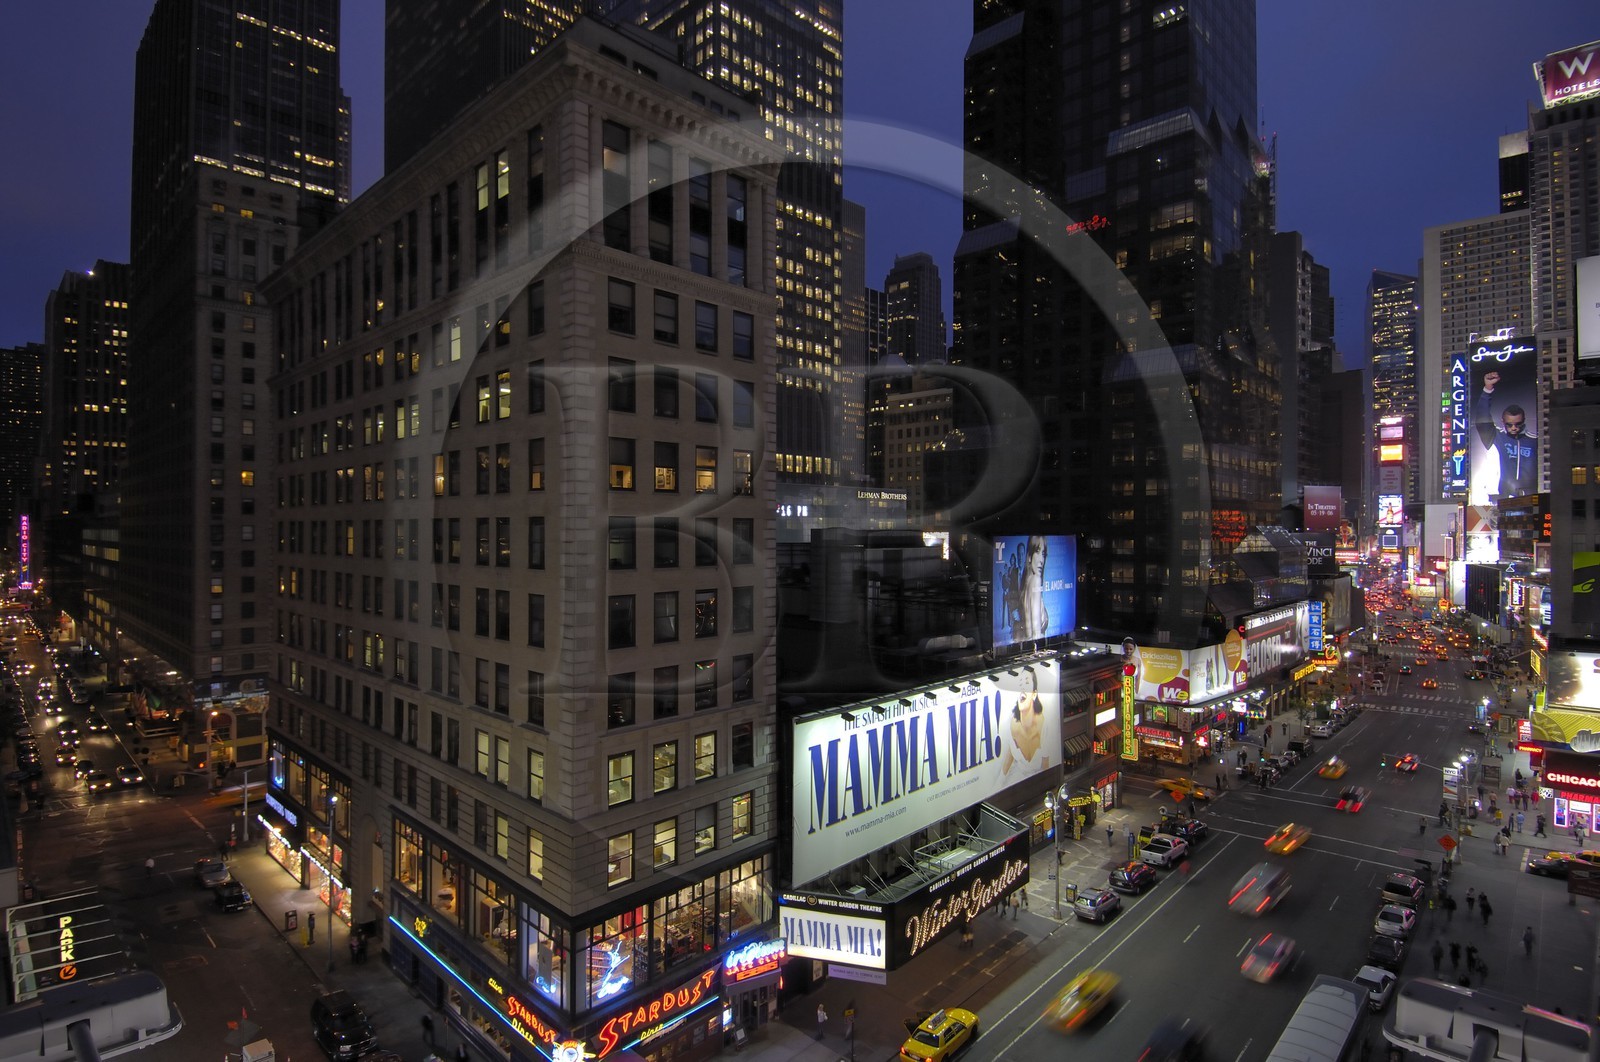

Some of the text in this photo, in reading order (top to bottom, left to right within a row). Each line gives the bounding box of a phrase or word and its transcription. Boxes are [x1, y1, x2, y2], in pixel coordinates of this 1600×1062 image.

[1558, 52, 1595, 79] W
[1451, 359, 1466, 445] ARGENT
[857, 490, 907, 500] LEHMAN BROTHERS
[1251, 634, 1281, 678] CLOSER
[808, 690, 1002, 835] MAMMA MIA!
[845, 806, 907, 837] www.mamma-mia.com
[929, 846, 1005, 893] CADILLAC WINTER GARDEN THEATRE
[783, 894, 882, 913] CADILLAC WINTER GARDEN THEATRE
[905, 860, 1028, 956] Winter Garden
[59, 916, 75, 962] PARK
[758, 951, 785, 965] CLUB
[783, 916, 881, 958] MAMMA MIA!
[507, 996, 558, 1043] STARDUST
[598, 969, 715, 1059] STARDUST
